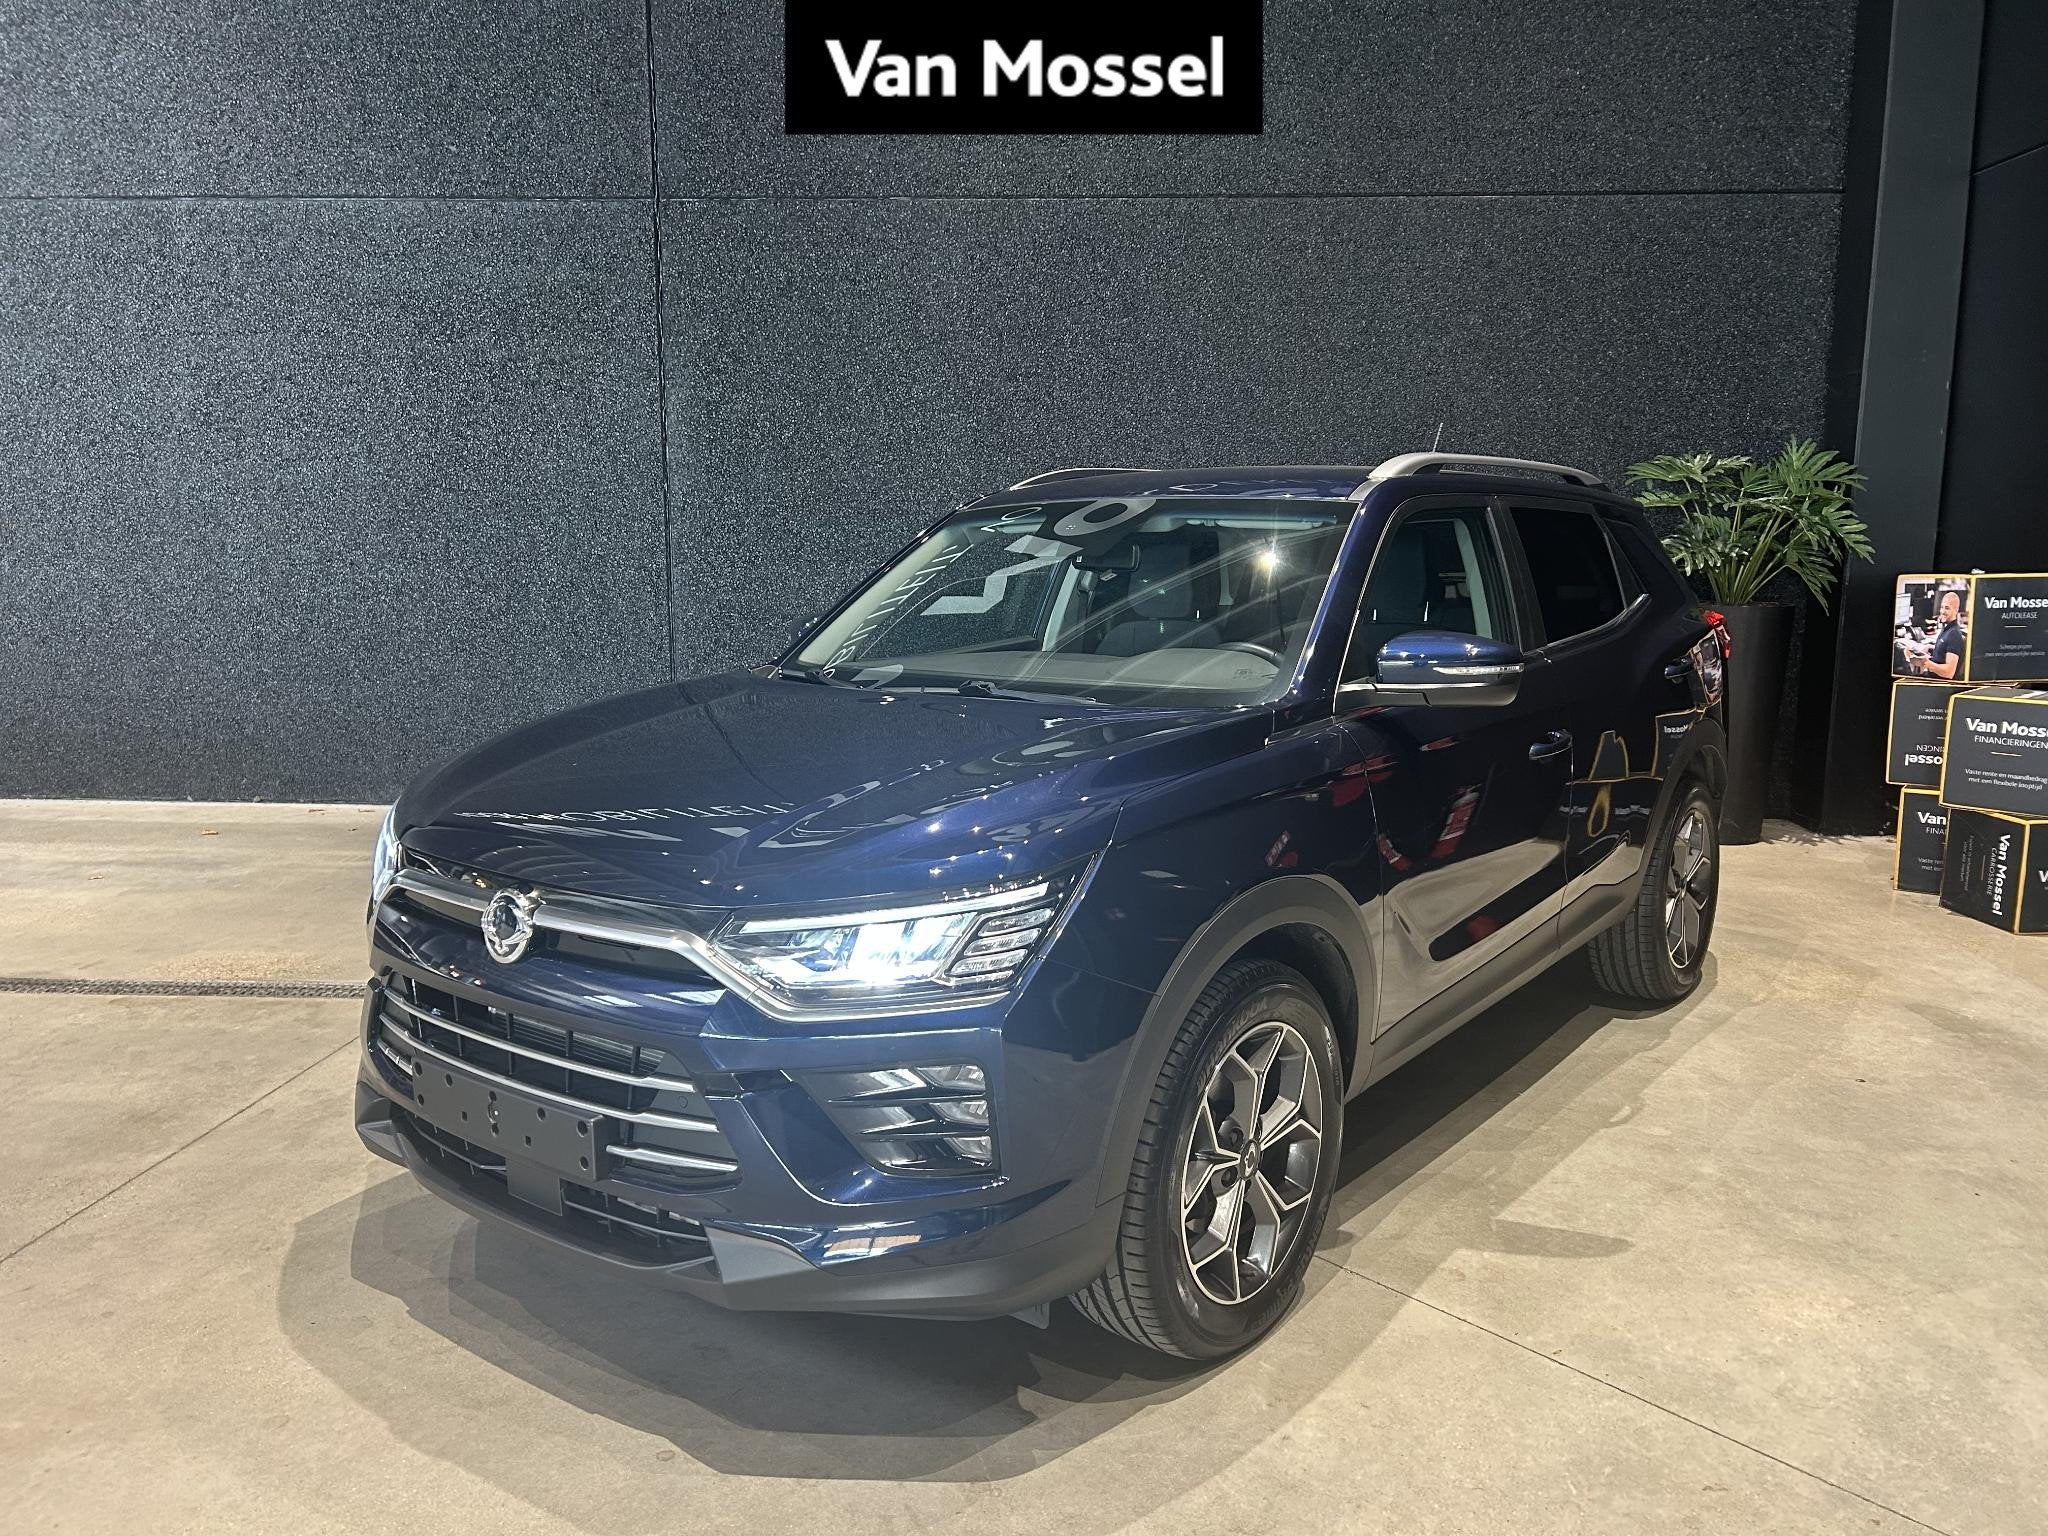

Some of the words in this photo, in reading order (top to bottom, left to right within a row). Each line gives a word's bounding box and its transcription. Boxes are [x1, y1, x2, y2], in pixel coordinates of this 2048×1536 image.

[1984, 596, 2008, 609] Van
[2010, 596, 2048, 609] Mosse
[2001, 611, 2038, 619] AUTOLEASE
[1965, 717, 1998, 733] Van
[2001, 721, 2048, 738] Moss
[1974, 735, 2048, 749] FINANCIERINGEN
[1904, 753, 1943, 766] ossel
[1917, 811, 1947, 826] Van
[1998, 834, 2011, 861] Van
[1992, 863, 2008, 916] Mossel
